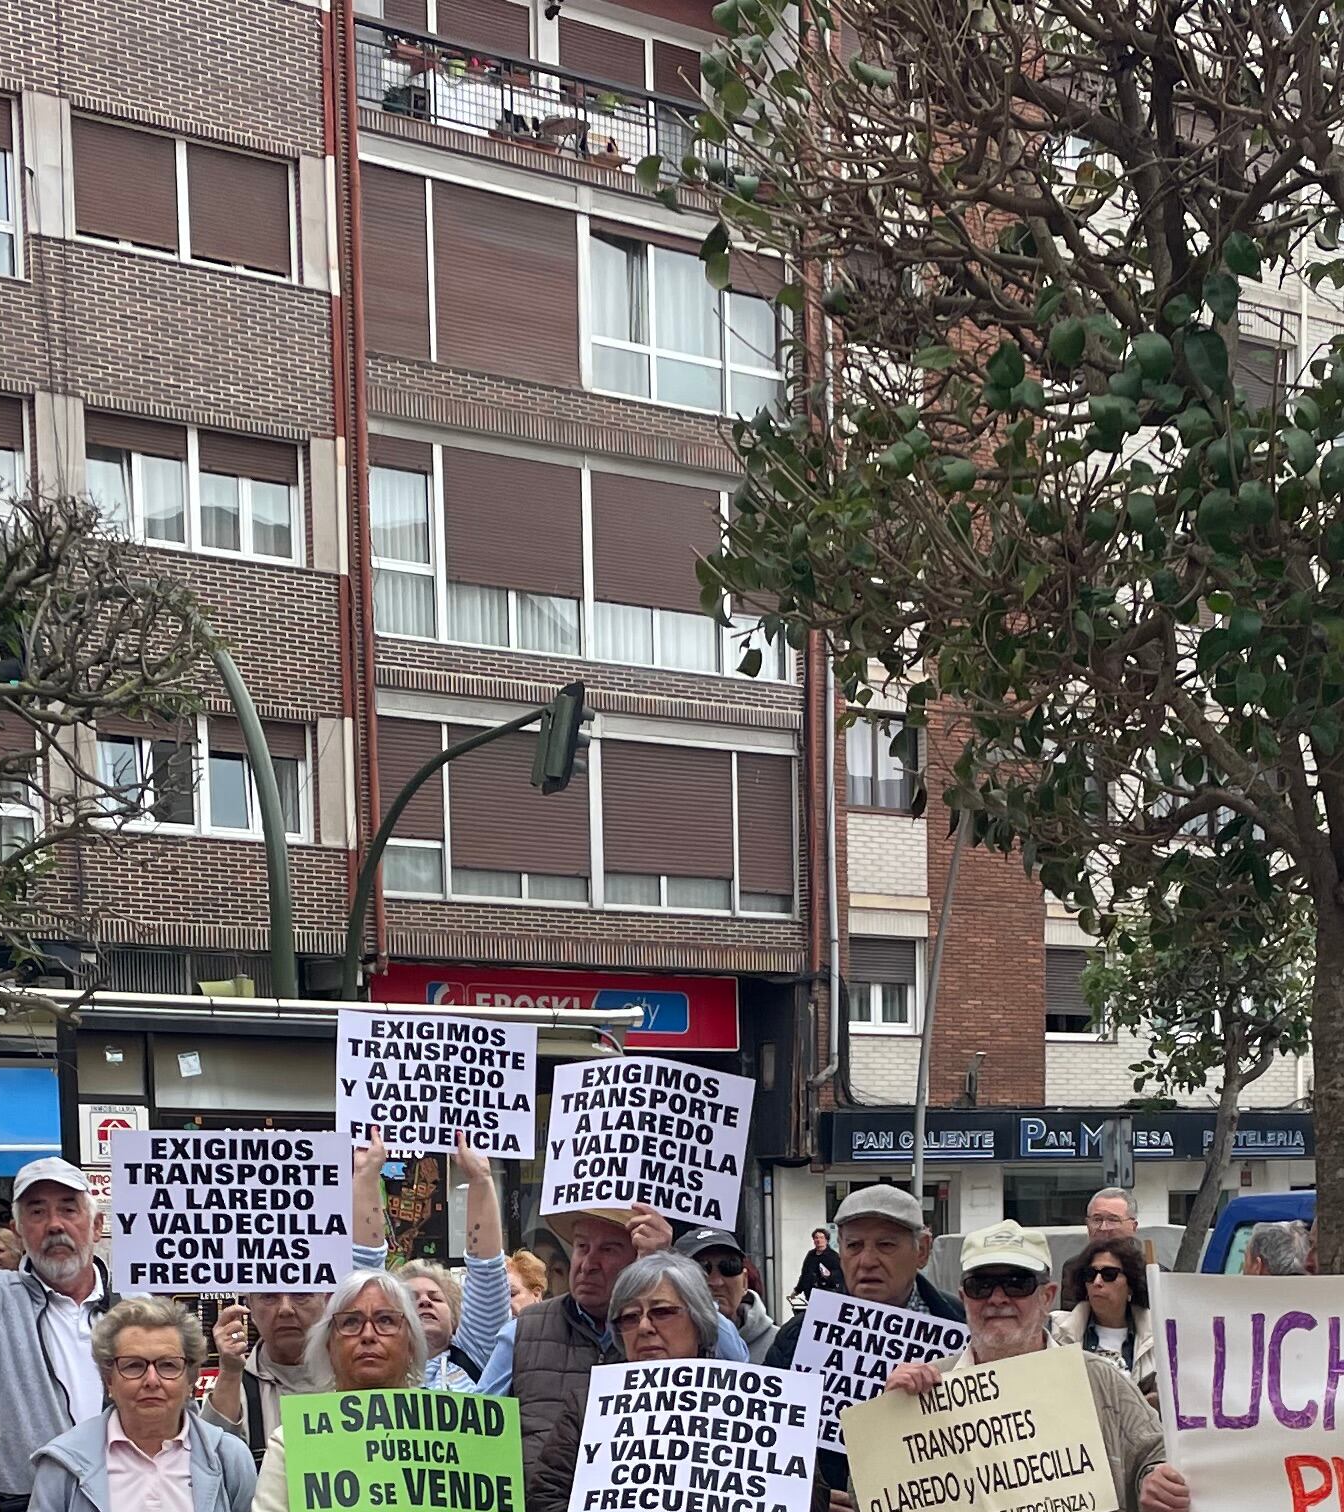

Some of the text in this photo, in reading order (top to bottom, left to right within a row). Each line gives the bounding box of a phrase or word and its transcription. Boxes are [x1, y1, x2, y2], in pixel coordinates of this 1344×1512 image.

[371, 1020, 506, 1046] EXIGIMOS
[348, 1038, 525, 1070] TRANSPORTE
[368, 1062, 504, 1088] A LAREDO
[581, 1063, 720, 1098] EXIGIMOS
[341, 1078, 530, 1112] Y VALDECILLA
[561, 1087, 739, 1128] TRANSPORTE
[371, 1104, 499, 1130] CON MAS
[575, 1110, 714, 1145] A LAREDO
[151, 1137, 314, 1160] EXIGIMOS
[551, 1139, 565, 1160] Y
[572, 1134, 738, 1176] VALDECILLA
[852, 1130, 994, 1149] PAN CLIENTE
[1080, 1121, 1174, 1157] MESA
[1202, 1130, 1305, 1147] PTELERIA
[124, 1163, 339, 1186] TRANSPORTE
[573, 1156, 628, 1179] CON
[639, 1159, 704, 1191] MAS
[150, 1188, 314, 1210] A LAREDO
[552, 1180, 722, 1221] FRECUENCIA
[116, 1213, 347, 1235] Y VALDECILLA
[156, 1238, 310, 1260] CON MAS
[130, 1263, 337, 1285] FRECUENCIA
[813, 1320, 954, 1363] TRANSPO
[623, 1366, 783, 1397] EXIGIMOS
[823, 1348, 898, 1382] A LA
[598, 1390, 806, 1427] TRANSPORTE
[918, 1370, 1000, 1416] MEJORES
[303, 1393, 505, 1437] LA SANIDAD
[614, 1415, 777, 1447] A LAREDO
[366, 1432, 460, 1464] PÚBLICA
[902, 1409, 1036, 1465] TRANSPORTES
[584, 1439, 808, 1479] Y VALDECILLA
[964, 1478, 975, 1505] y
[976, 1444, 1095, 1495] VALDECILLA
[303, 1469, 360, 1510] NO
[369, 1482, 398, 1506] SE
[611, 1463, 766, 1497] CON MAS
